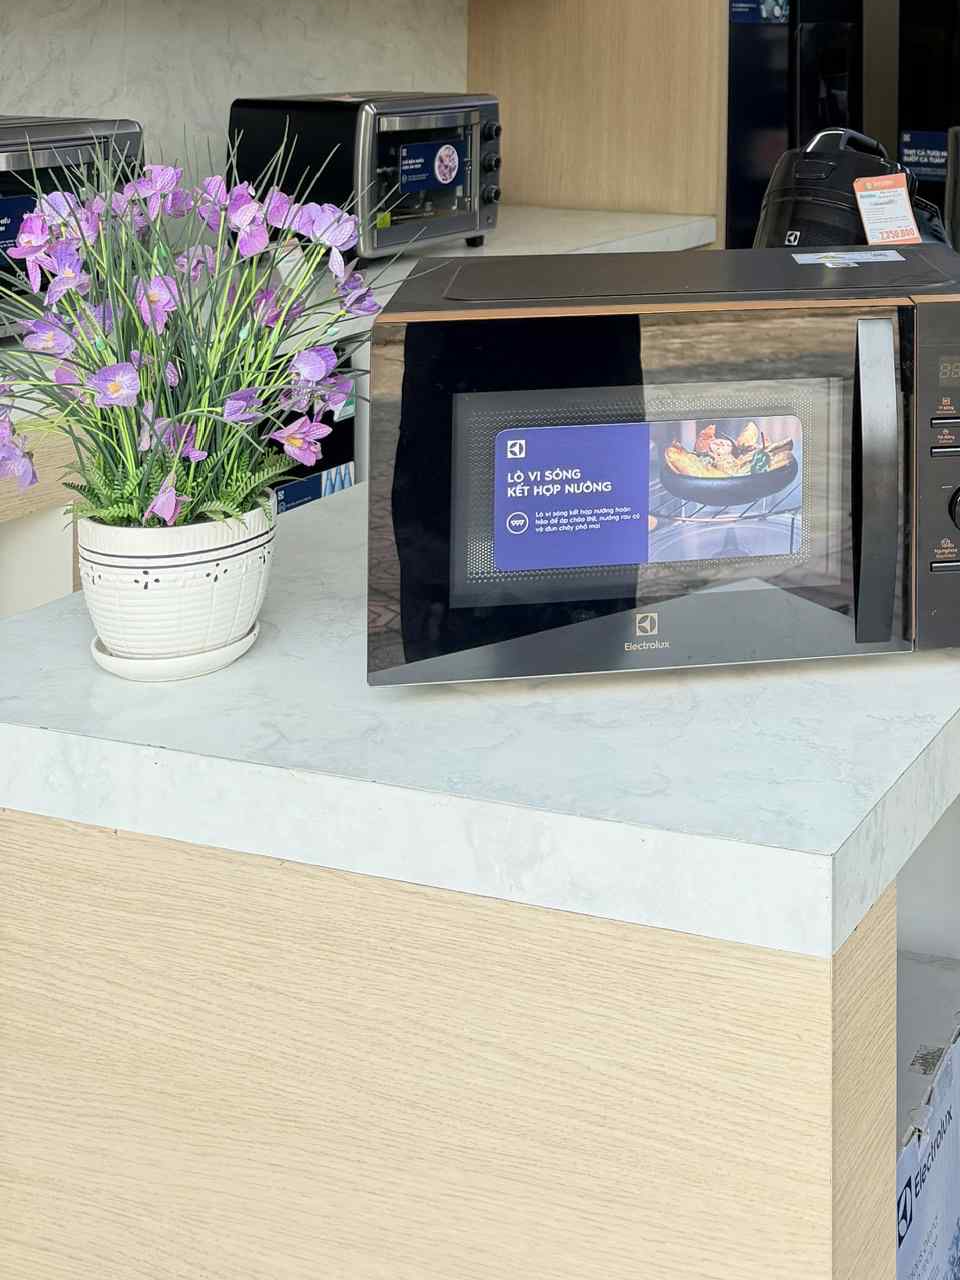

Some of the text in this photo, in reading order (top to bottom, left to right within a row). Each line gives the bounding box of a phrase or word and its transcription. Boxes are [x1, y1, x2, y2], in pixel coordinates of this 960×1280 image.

[507, 467, 581, 483] LÒ VI SÓNG
[507, 480, 612, 497] KẾT HỢP NƯỚNG
[624, 640, 671, 651] Electrolux
[913, 1104, 953, 1199] Electrolux
